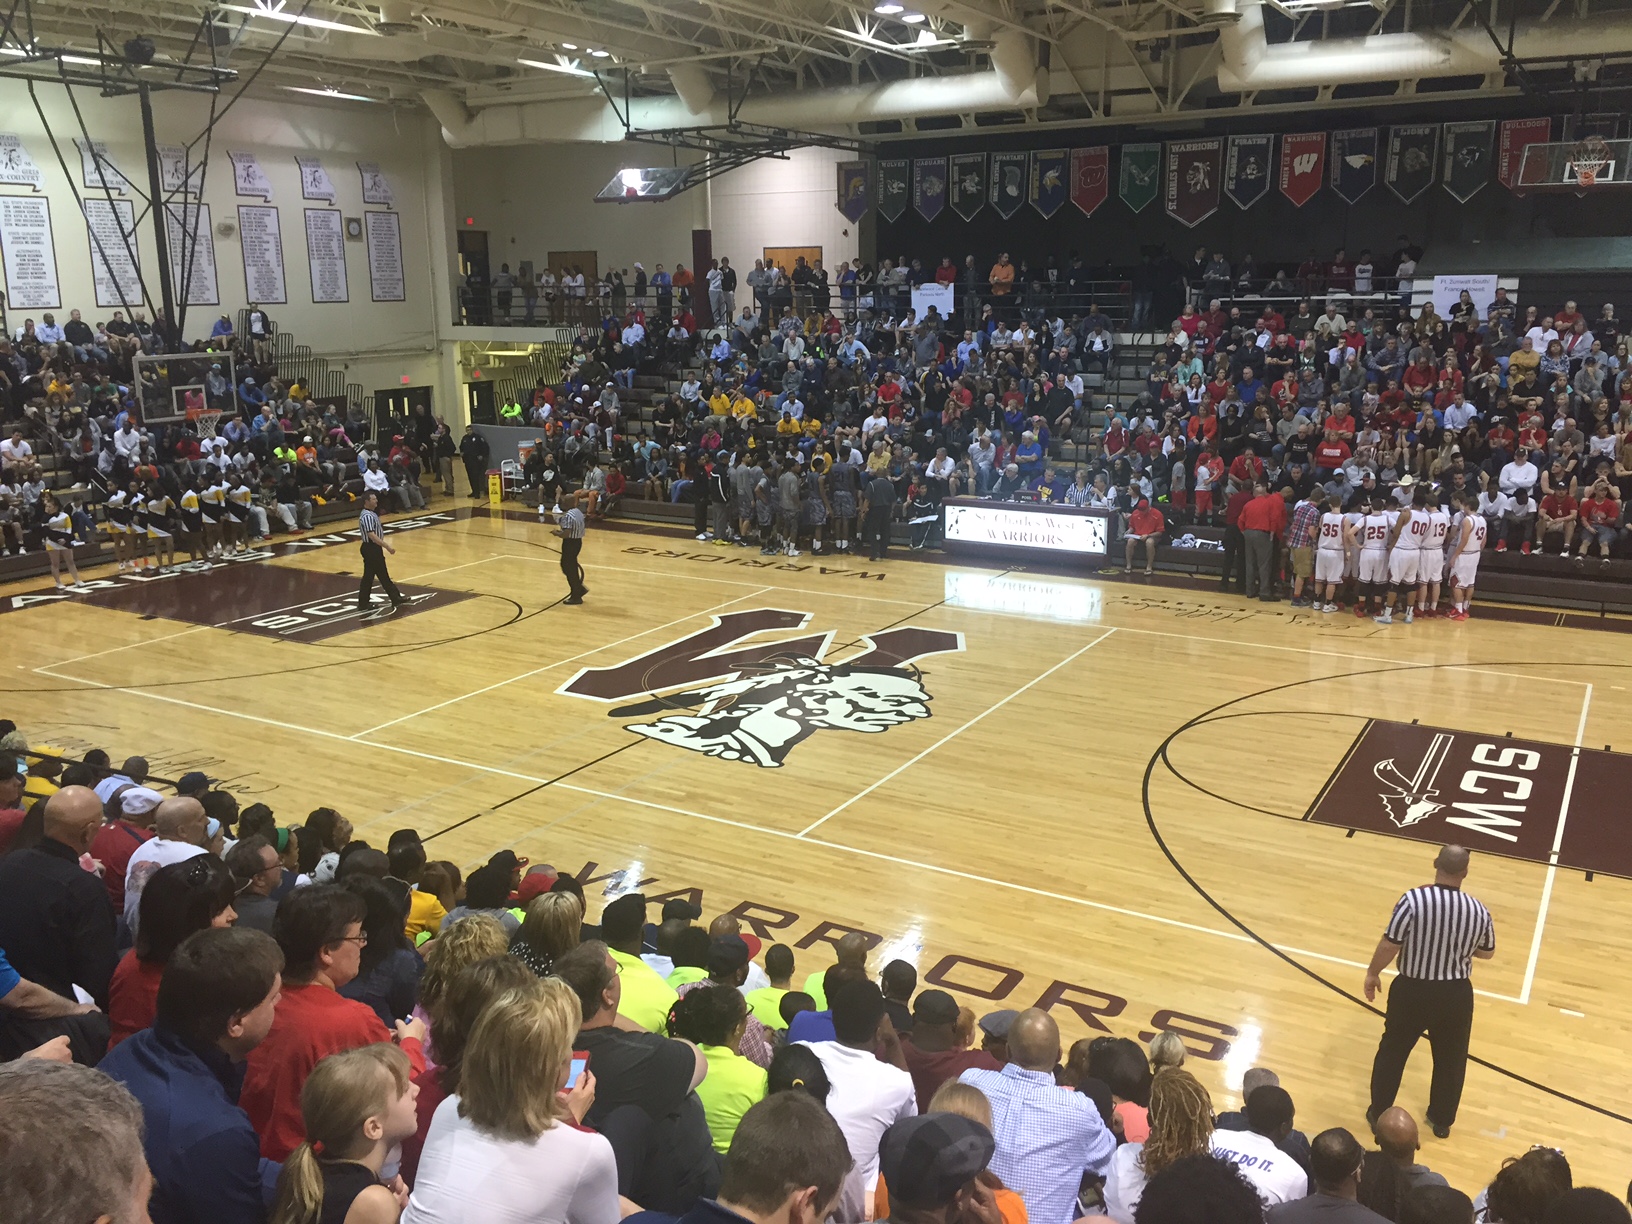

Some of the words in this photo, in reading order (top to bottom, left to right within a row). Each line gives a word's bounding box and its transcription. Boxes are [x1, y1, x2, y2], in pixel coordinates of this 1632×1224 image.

[1287, 134, 1322, 142] WARRIORS
[1171, 141, 1219, 152] WARRIORS
[917, 159, 945, 167] JAGUARS
[1170, 154, 1179, 171] WEST
[1169, 172, 1178, 199] CHARLES
[994, 513, 1041, 527] Charles
[1045, 517, 1075, 530] West
[1411, 520, 1427, 535] 00
[987, 528, 1064, 546] WARRIORS
[1322, 523, 1339, 538] 35
[1367, 525, 1387, 540] 25
[1434, 522, 1446, 538] 13
[1475, 526, 1485, 541] 43
[621, 546, 887, 581] WARRIORS
[1445, 743, 1541, 843] SCW
[574, 861, 1239, 1062] WARRORS
[1238, 1153, 1259, 1167] DO
[1258, 1159, 1274, 1173] IT.
